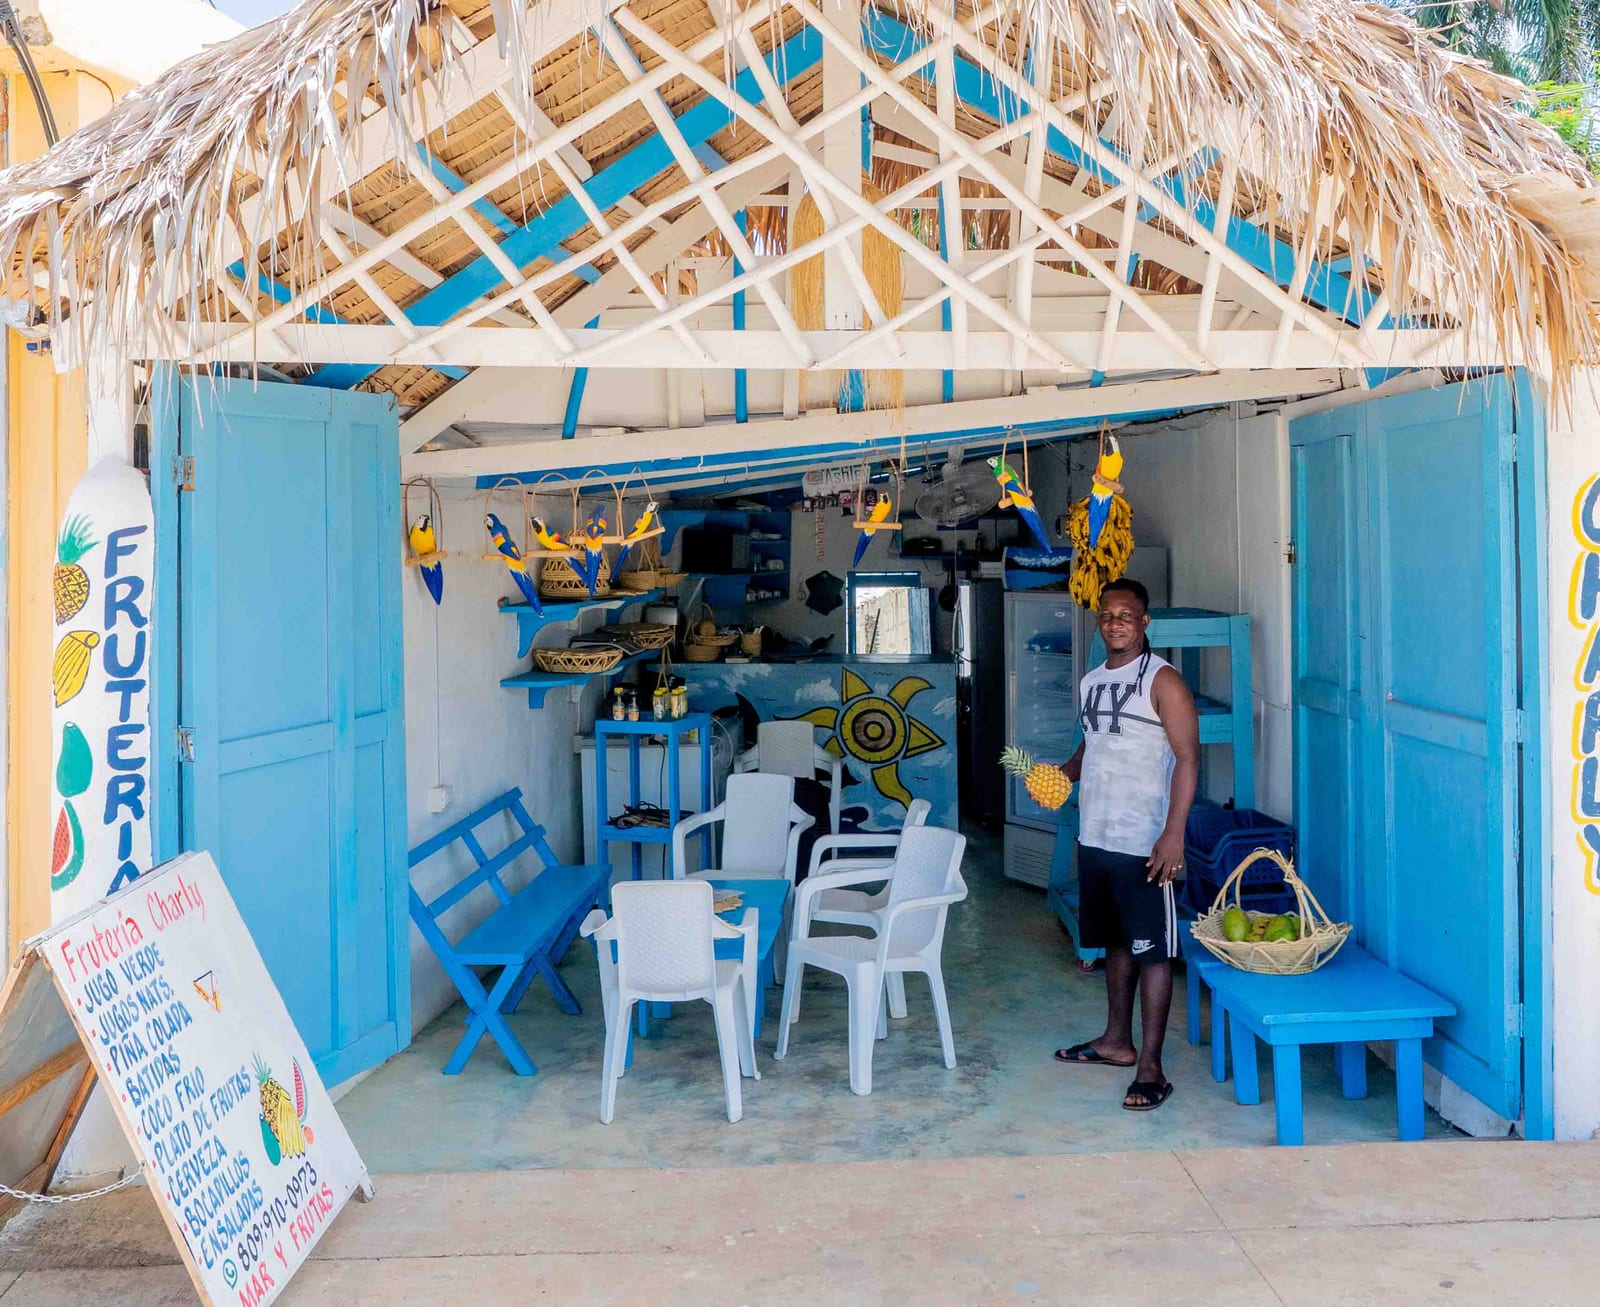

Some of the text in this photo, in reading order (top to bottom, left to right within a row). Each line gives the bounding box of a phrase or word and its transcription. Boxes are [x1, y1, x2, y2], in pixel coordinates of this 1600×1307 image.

[1081, 681, 1138, 737] NY
[148, 875, 206, 931] Charly
[84, 942, 165, 1014] JUGO VERDE
[99, 975, 174, 1046] JUGOS NATS.
[110, 1000, 192, 1076] PIÑA COLADA
[126, 1045, 181, 1107] BATIDAS
[141, 1066, 205, 1140] COCO FRIO
[154, 1064, 252, 1174] PLATO DE FRUTAS
[169, 1136, 228, 1207] CERVEZA
[184, 1150, 250, 1237] BOCADILLOS
[201, 1179, 265, 1269] ENSALADAS
[239, 1181, 334, 1307] MAR Y FRUTAS
